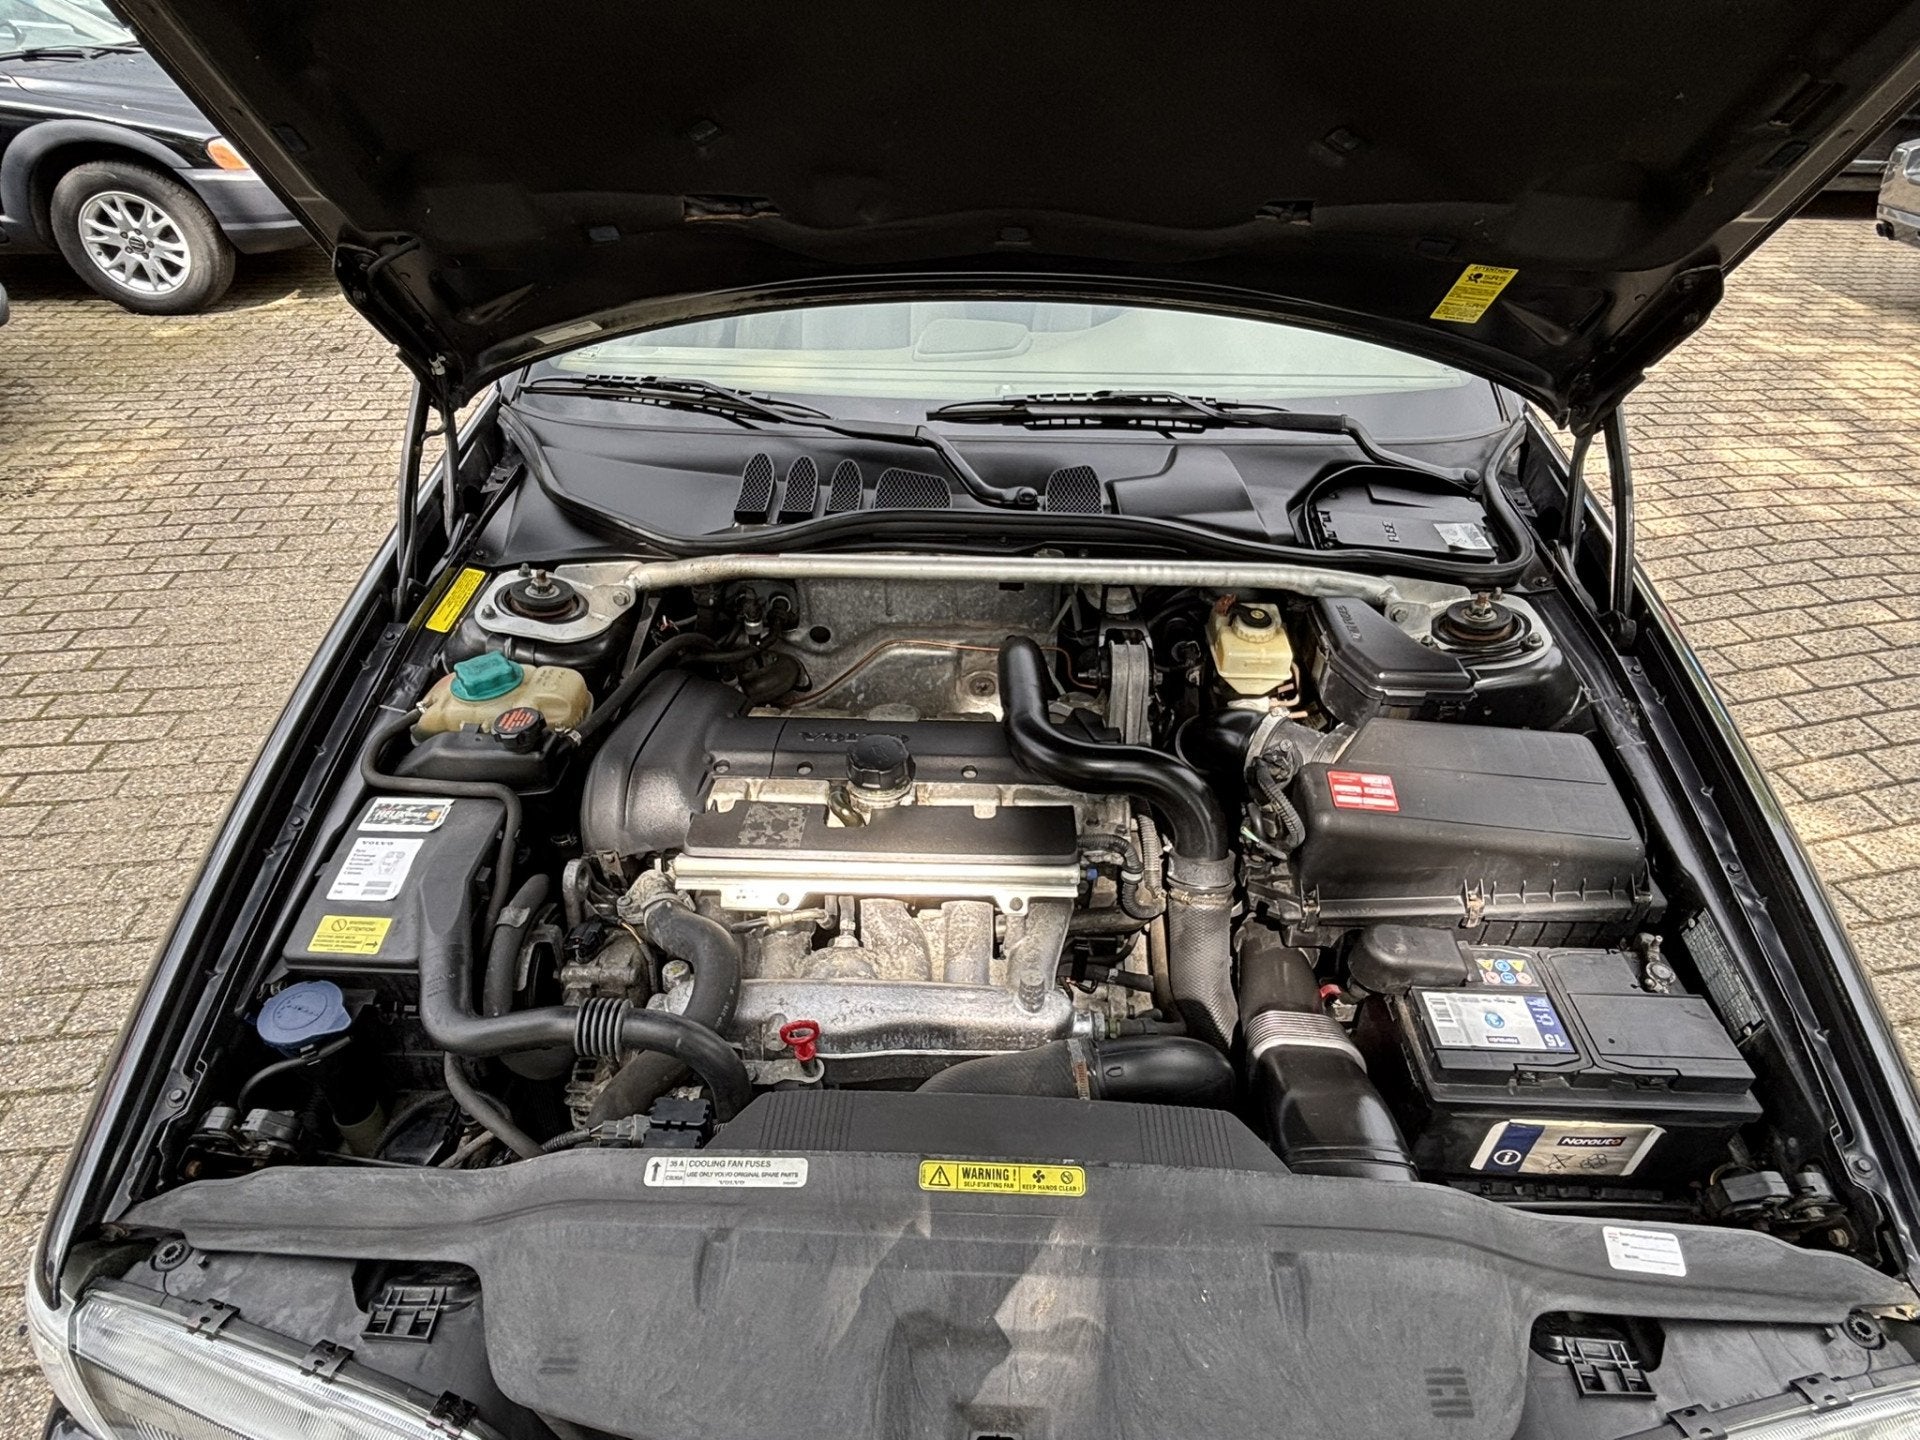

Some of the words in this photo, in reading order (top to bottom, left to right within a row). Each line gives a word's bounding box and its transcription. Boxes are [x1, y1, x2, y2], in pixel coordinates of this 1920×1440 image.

[1544, 1033, 1566, 1047] 15
[1561, 1137, 1622, 1146] Norauto
[688, 1160, 726, 1168] COOLING
[727, 1160, 744, 1168] FAN
[744, 1160, 771, 1168] FUSES
[961, 1167, 1009, 1181] WARNING
[963, 1181, 1003, 1189] SELF-STARTING
